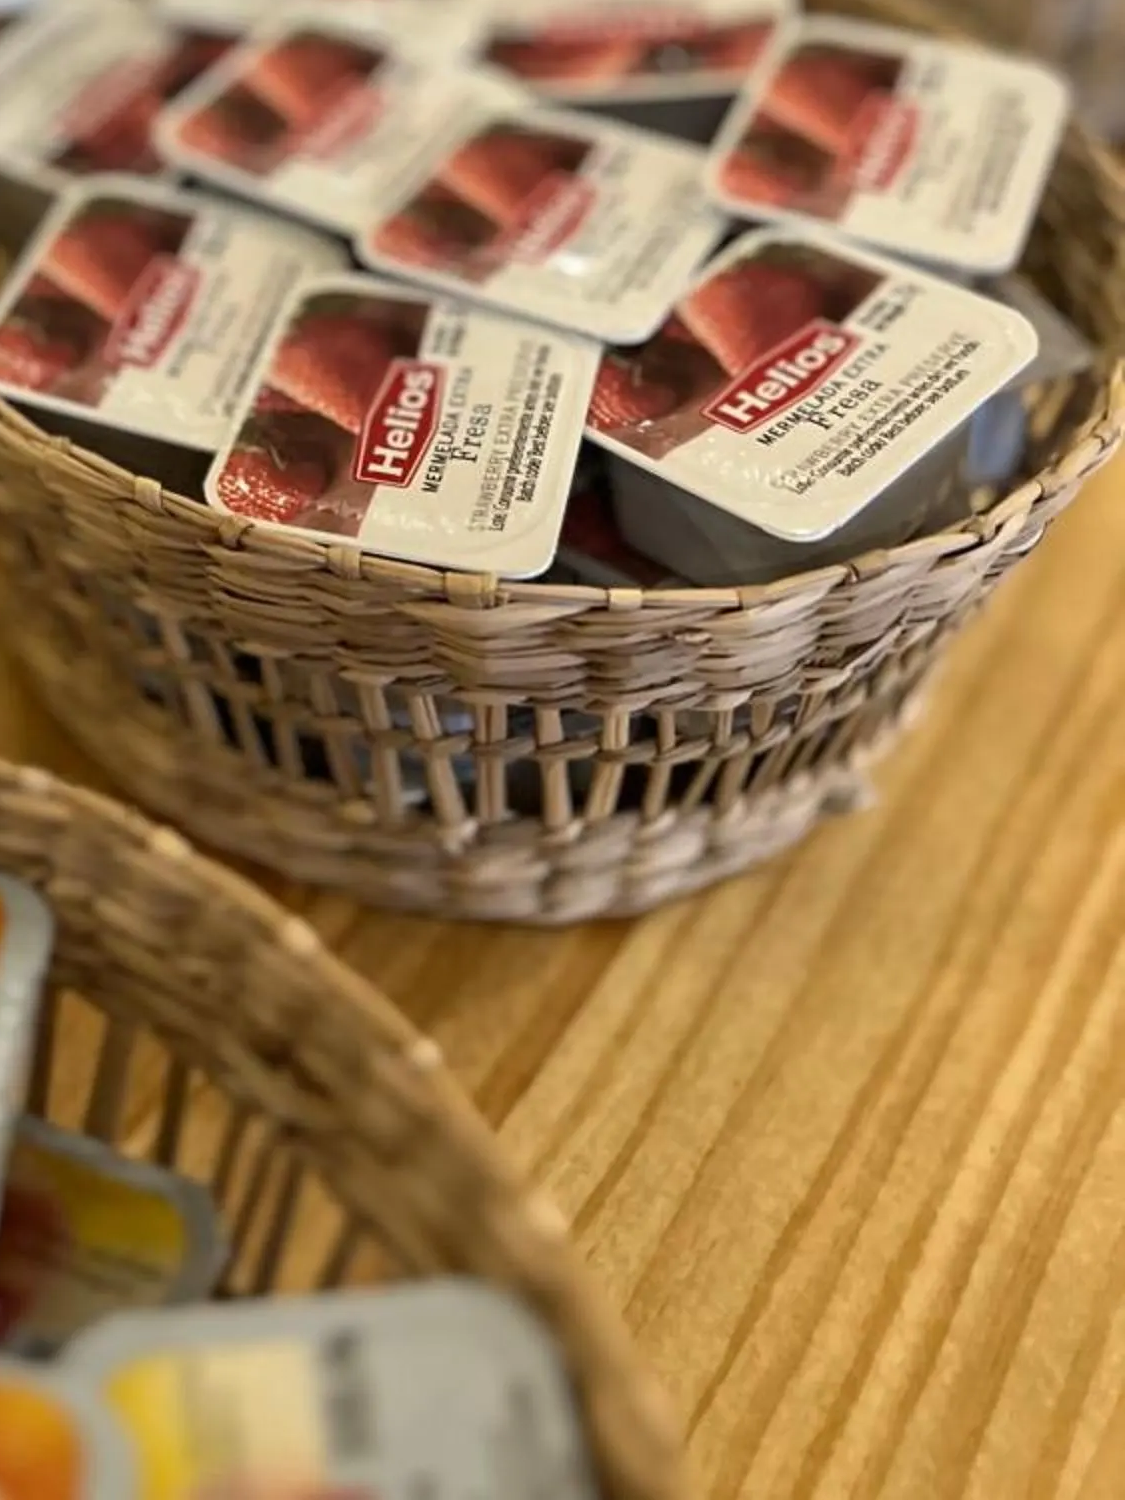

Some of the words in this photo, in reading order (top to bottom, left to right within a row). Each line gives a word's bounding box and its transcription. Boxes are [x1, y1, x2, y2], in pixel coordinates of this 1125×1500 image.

[716, 328, 847, 425] Helios
[755, 378, 847, 448] MERMELADA
[841, 343, 890, 380] EXTRA
[807, 376, 883, 430] Fresa
[367, 368, 435, 477] Helios
[422, 412, 461, 493] MERMELADA
[449, 402, 493, 463] Fresa
